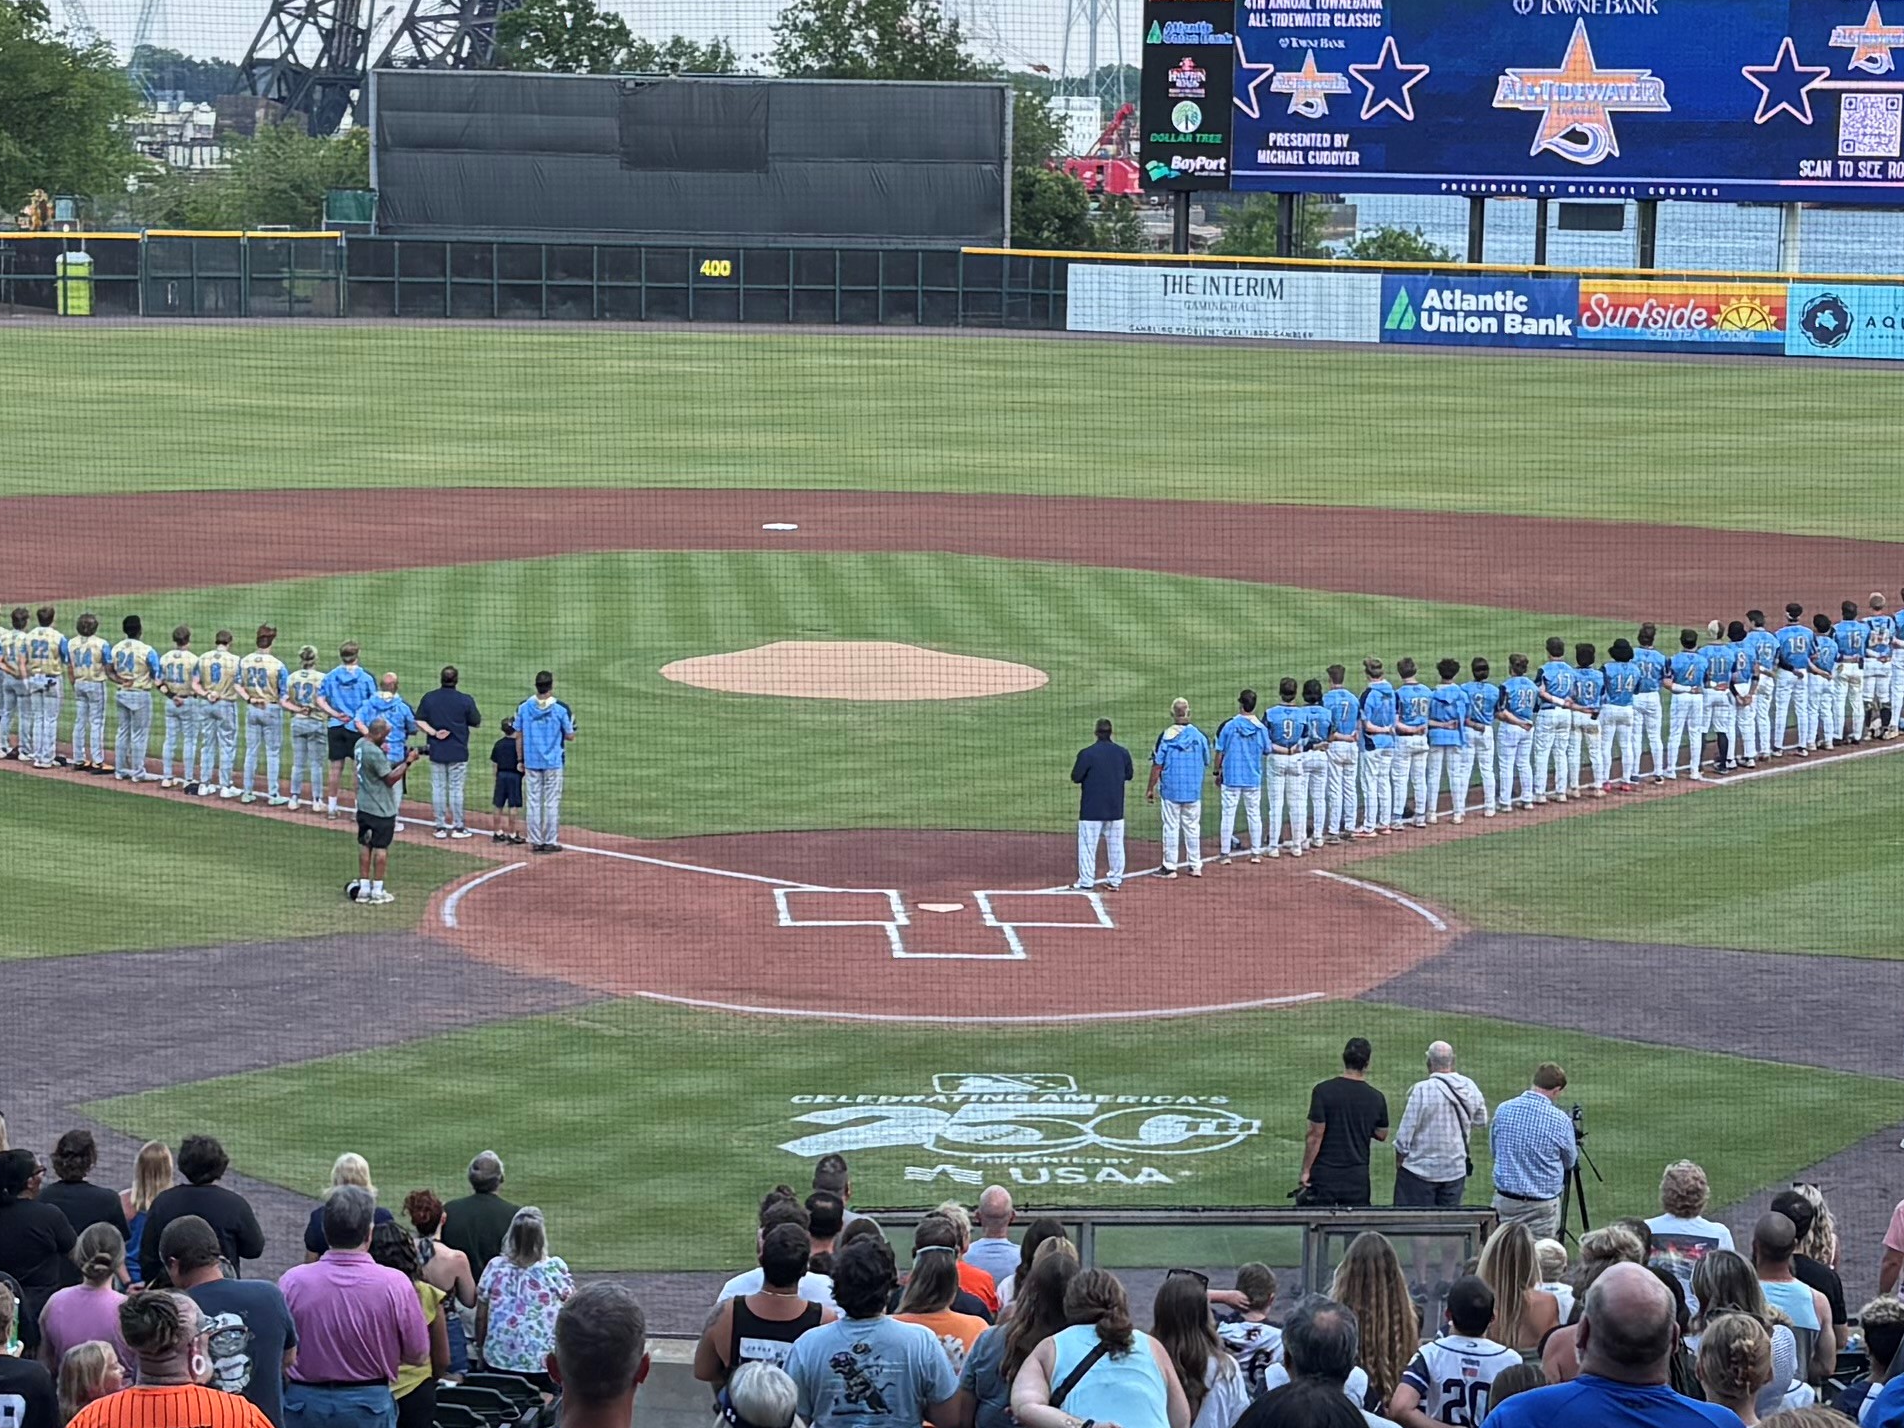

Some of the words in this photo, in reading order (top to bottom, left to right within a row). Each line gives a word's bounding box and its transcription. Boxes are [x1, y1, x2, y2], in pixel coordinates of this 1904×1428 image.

[1248, 13, 1330, 27] ALL-TIDEWATER
[1333, 12, 1381, 27] CLASSIC
[1150, 133, 1192, 143] DOLLAR
[1269, 133, 1330, 147] PRESENTED
[1333, 133, 1349, 147] BY
[1171, 155, 1226, 172] BayPort
[1257, 150, 1304, 164] MICHAEL
[1799, 160, 1832, 178] SCAN
[1838, 161, 1853, 178] TO
[1857, 161, 1884, 178] SEE
[699, 259, 732, 277] 400
[1161, 274, 1197, 297] THE
[1202, 276, 1284, 301] INTERIM
[1421, 288, 1528, 312] Atlantic
[1581, 293, 1707, 332] Surfside
[1420, 311, 1498, 334] Union
[1504, 313, 1574, 337] Bank
[1790, 636, 1807, 654] 19
[1685, 664, 1694, 681] 4
[1711, 657, 1725, 675] 11
[1616, 674, 1634, 692] 14
[1341, 700, 1350, 718] 7
[1283, 720, 1293, 739] 9
[1009, 1167, 1174, 1184] USAA
